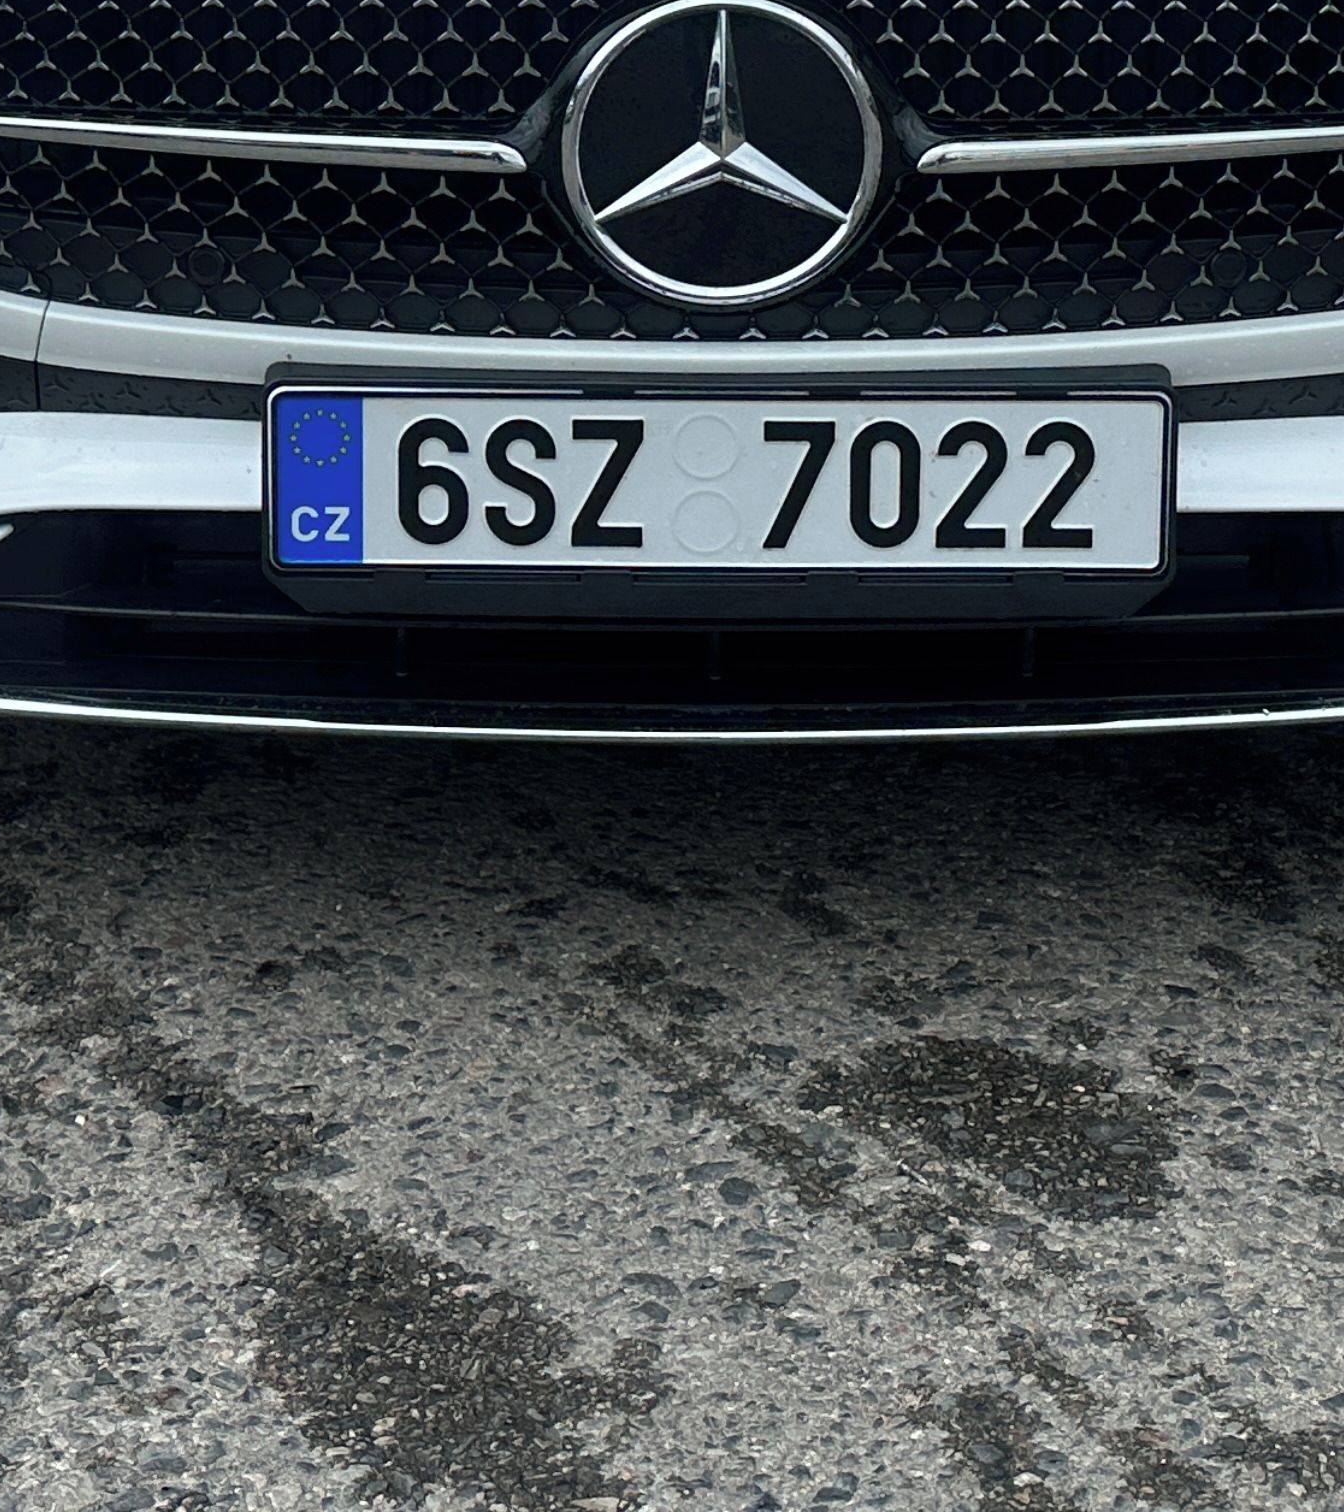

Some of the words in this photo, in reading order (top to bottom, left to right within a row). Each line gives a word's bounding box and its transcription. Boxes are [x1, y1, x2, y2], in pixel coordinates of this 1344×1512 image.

[291, 506, 350, 542] CZ
[398, 417, 645, 548] 6SZ
[761, 420, 1096, 549] 7022
